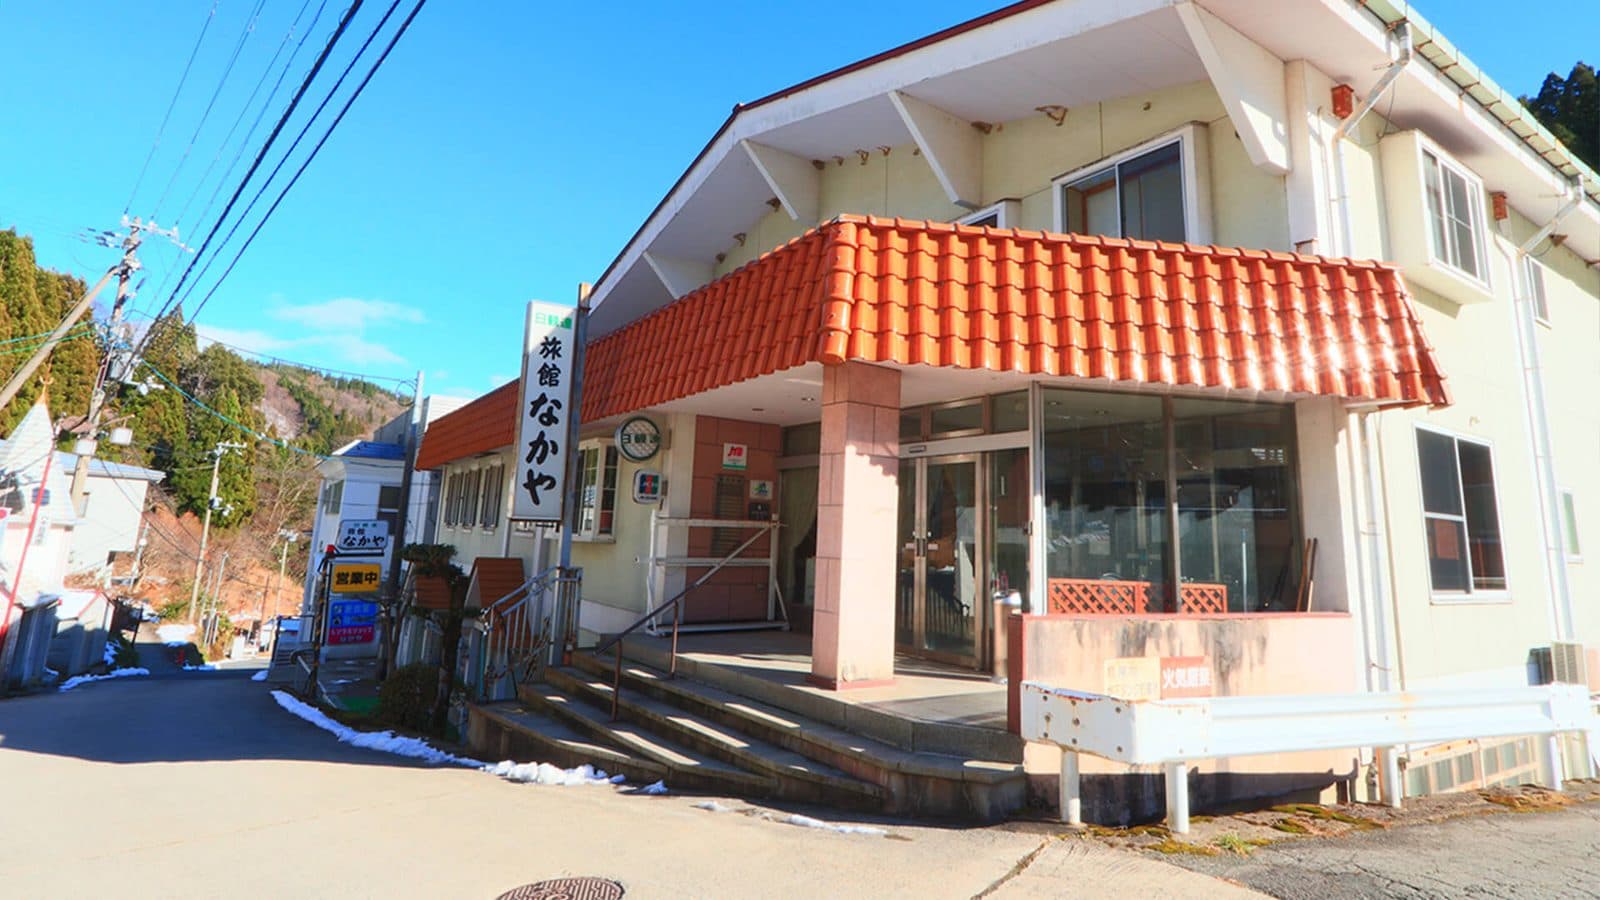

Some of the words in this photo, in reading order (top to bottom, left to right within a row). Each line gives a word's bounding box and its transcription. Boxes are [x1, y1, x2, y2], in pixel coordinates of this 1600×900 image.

[523, 336, 563, 506] 旅館なかや
[343, 535, 385, 547] なかや
[336, 571, 377, 585] 営業中
